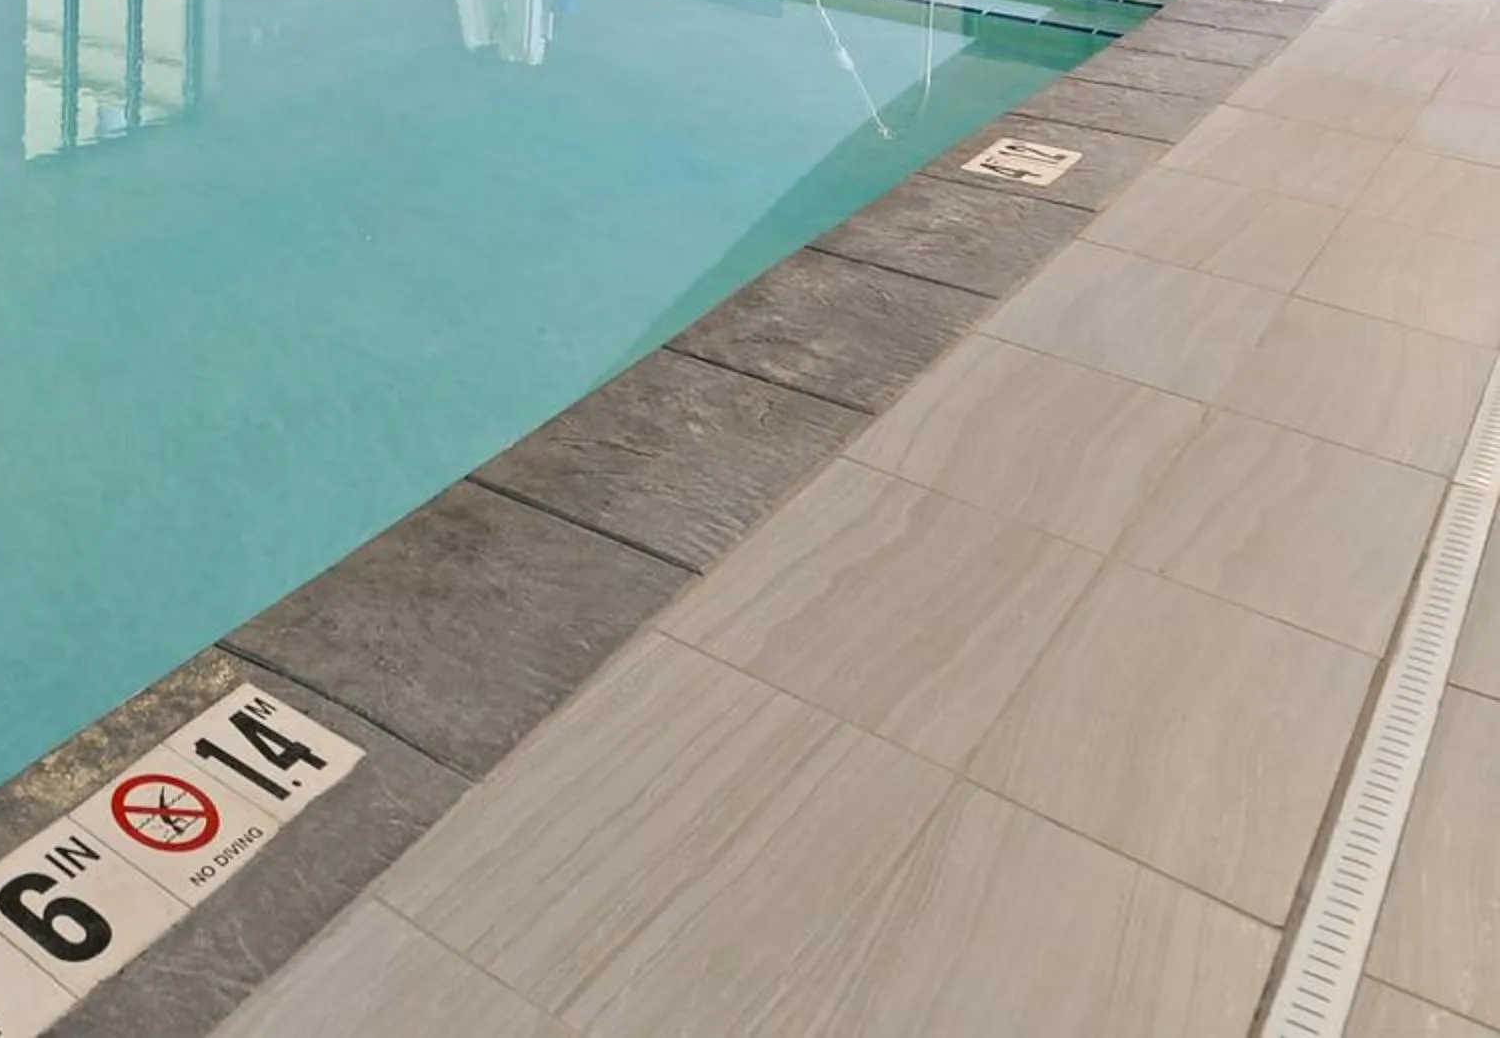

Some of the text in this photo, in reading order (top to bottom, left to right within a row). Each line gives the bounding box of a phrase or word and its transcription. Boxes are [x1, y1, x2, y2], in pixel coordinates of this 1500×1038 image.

[244, 697, 278, 720] M
[195, 710, 328, 801] 1.4
[45, 835, 100, 879] IN
[190, 826, 264, 887] NO DIVING
